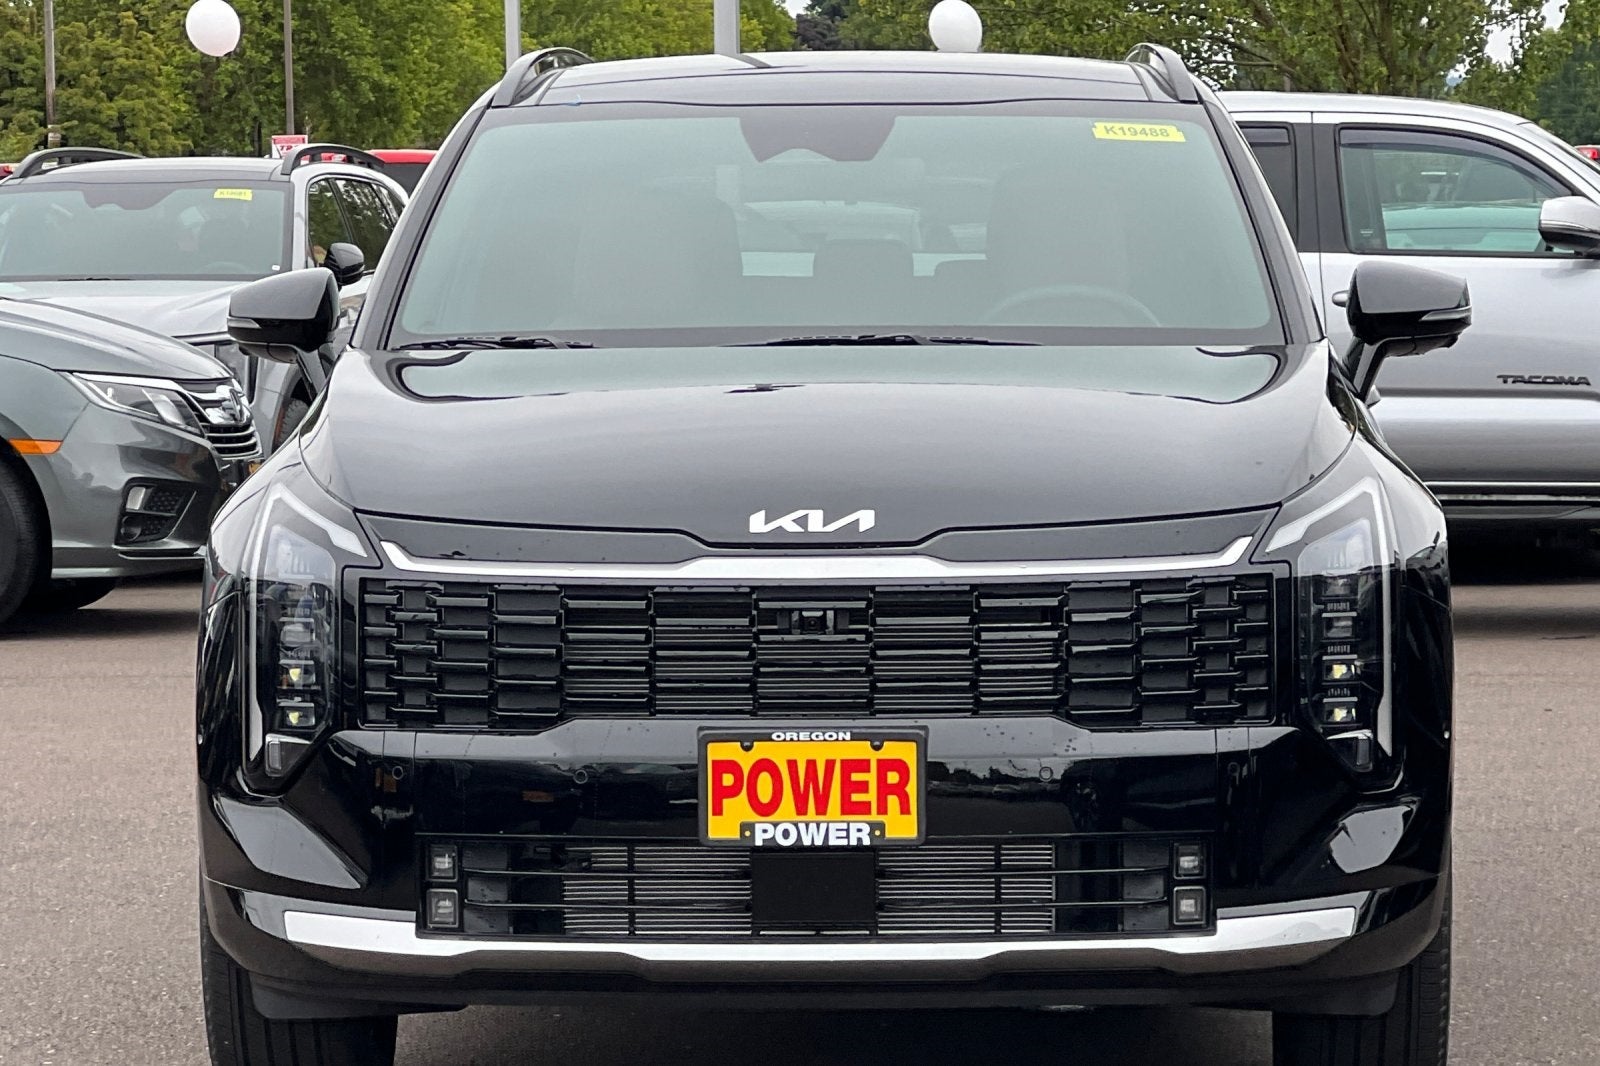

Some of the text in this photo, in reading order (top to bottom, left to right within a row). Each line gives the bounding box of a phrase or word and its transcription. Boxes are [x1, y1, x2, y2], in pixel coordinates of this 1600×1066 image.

[1103, 125, 1170, 138] K19488
[1496, 374, 1592, 386] TACOMA
[749, 509, 876, 533] KIA
[771, 731, 851, 742] OREGON
[711, 758, 912, 817] POWER
[754, 822, 871, 847] POWER
